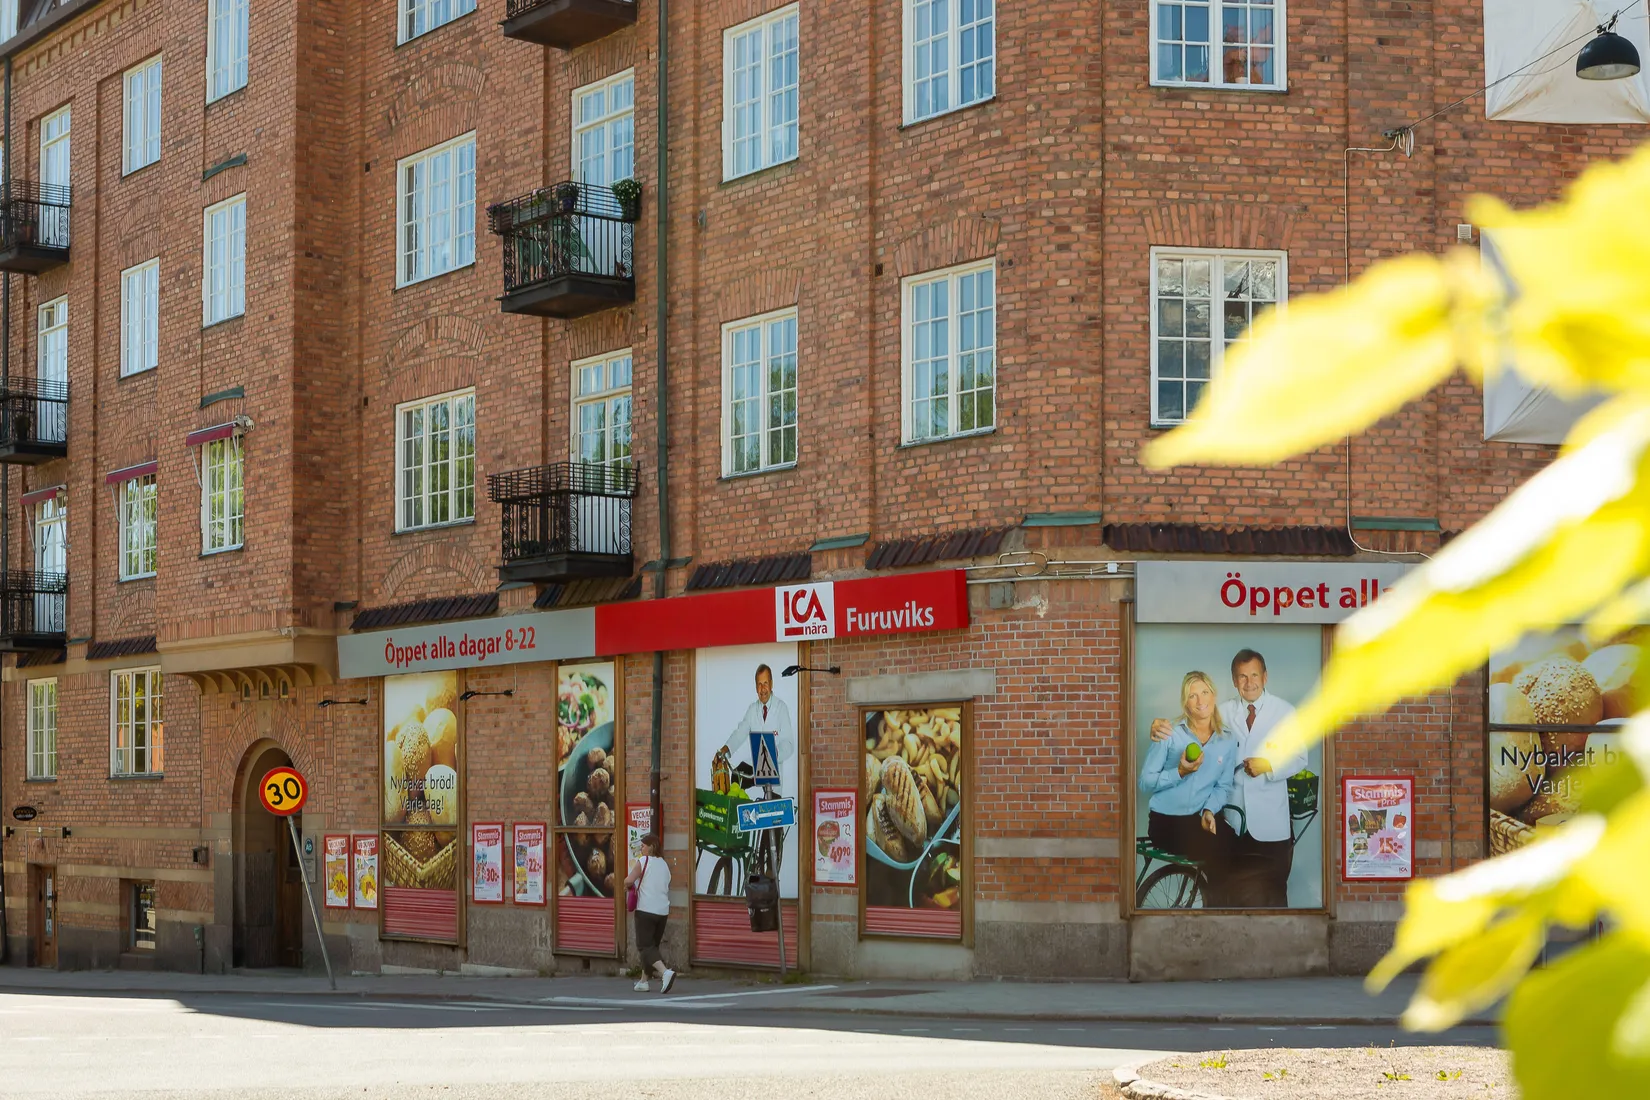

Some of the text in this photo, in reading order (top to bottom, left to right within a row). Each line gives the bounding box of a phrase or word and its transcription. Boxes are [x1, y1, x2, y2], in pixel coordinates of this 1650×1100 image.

[783, 588, 827, 624] ICA
[1220, 572, 1330, 616] Öppet
[804, 622, 828, 636] nära
[846, 600, 934, 632] Furuviks
[385, 626, 536, 668] Öppet alla dagar 8-22
[1500, 743, 1598, 773] Nybakat
[266, 777, 301, 806] 30
[390, 772, 455, 794] Nybakat bröd!
[1355, 787, 1404, 799] Stammis
[400, 793, 445, 816] Varje dag!
